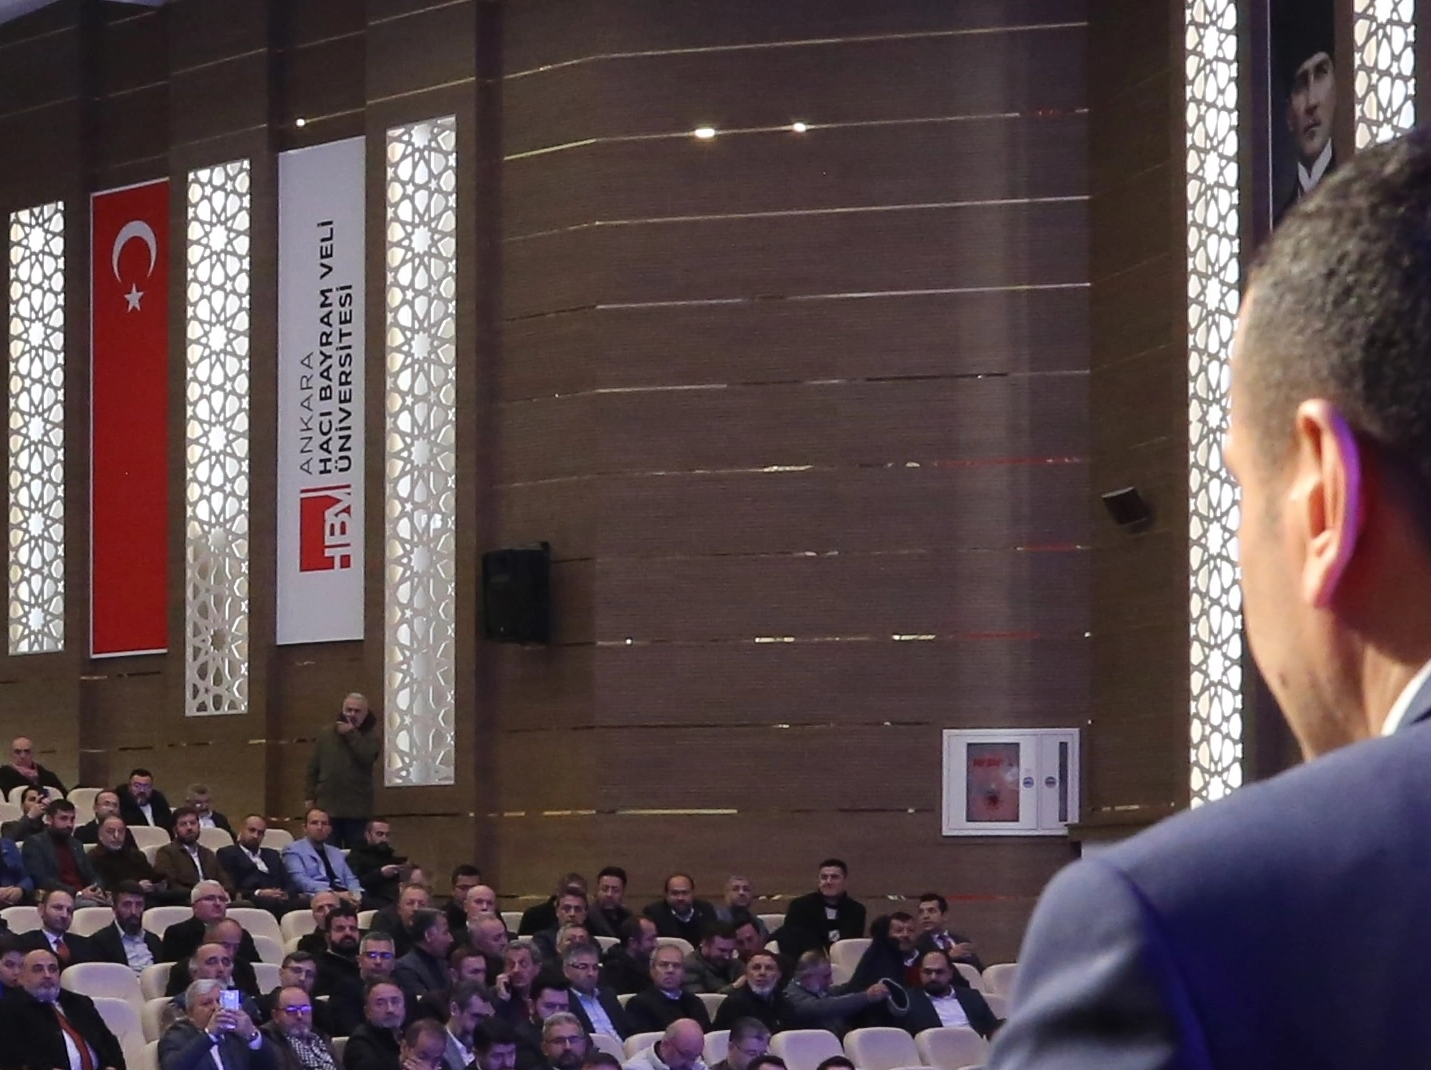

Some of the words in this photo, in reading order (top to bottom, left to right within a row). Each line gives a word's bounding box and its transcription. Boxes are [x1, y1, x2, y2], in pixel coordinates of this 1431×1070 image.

[317, 220, 333, 280] VELİ
[319, 288, 333, 401] BAYRAM
[335, 285, 352, 473] ÜNİVERSİTESİ
[300, 352, 314, 475] ANKARA
[319, 411, 333, 475] HACI
